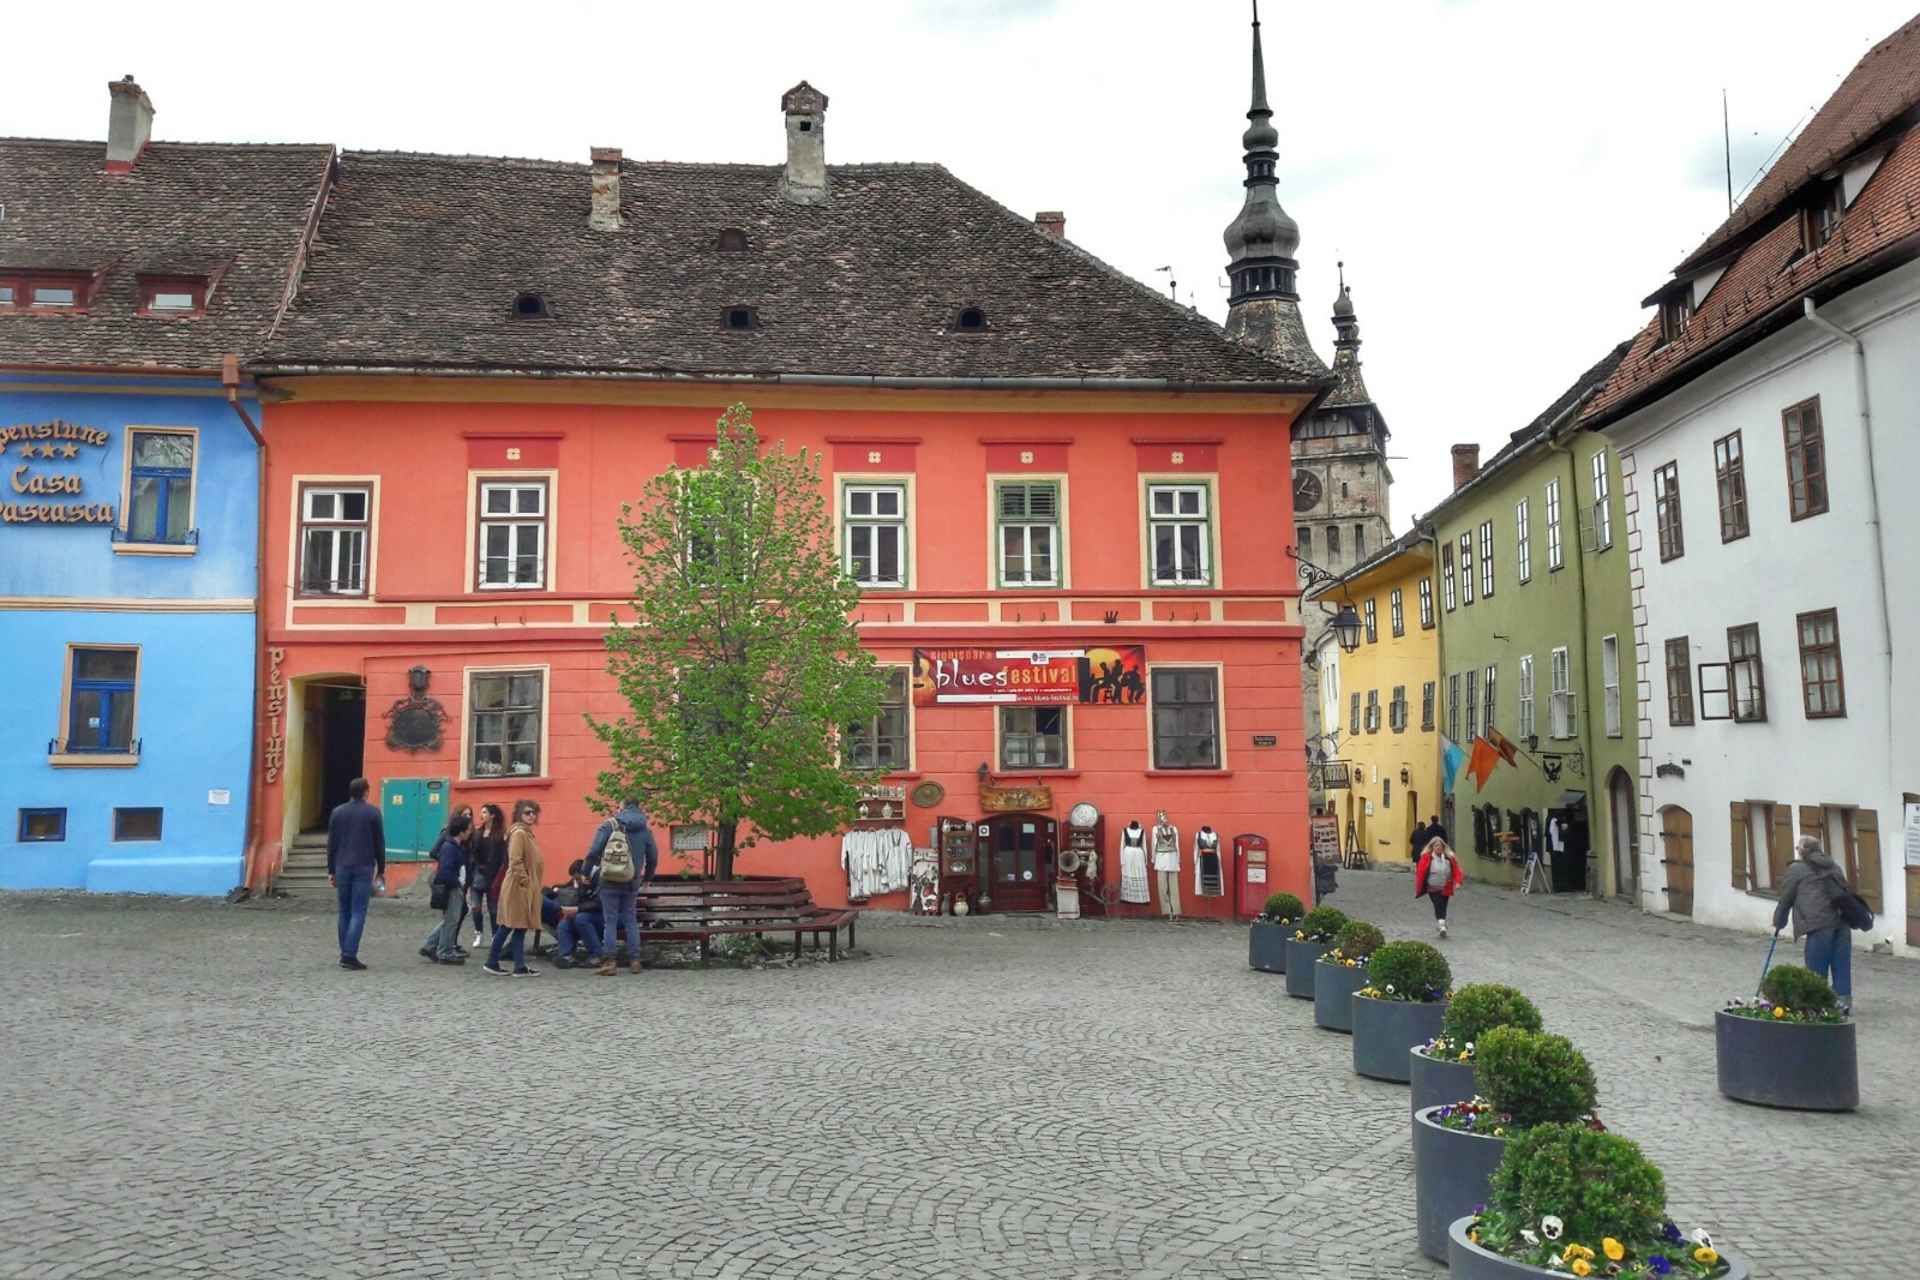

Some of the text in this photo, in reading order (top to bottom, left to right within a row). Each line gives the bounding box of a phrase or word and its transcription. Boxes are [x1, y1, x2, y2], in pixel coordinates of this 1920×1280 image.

[11, 464, 81, 494] Casa
[0, 502, 113, 523] aseasca
[936, 659, 1008, 688] blues
